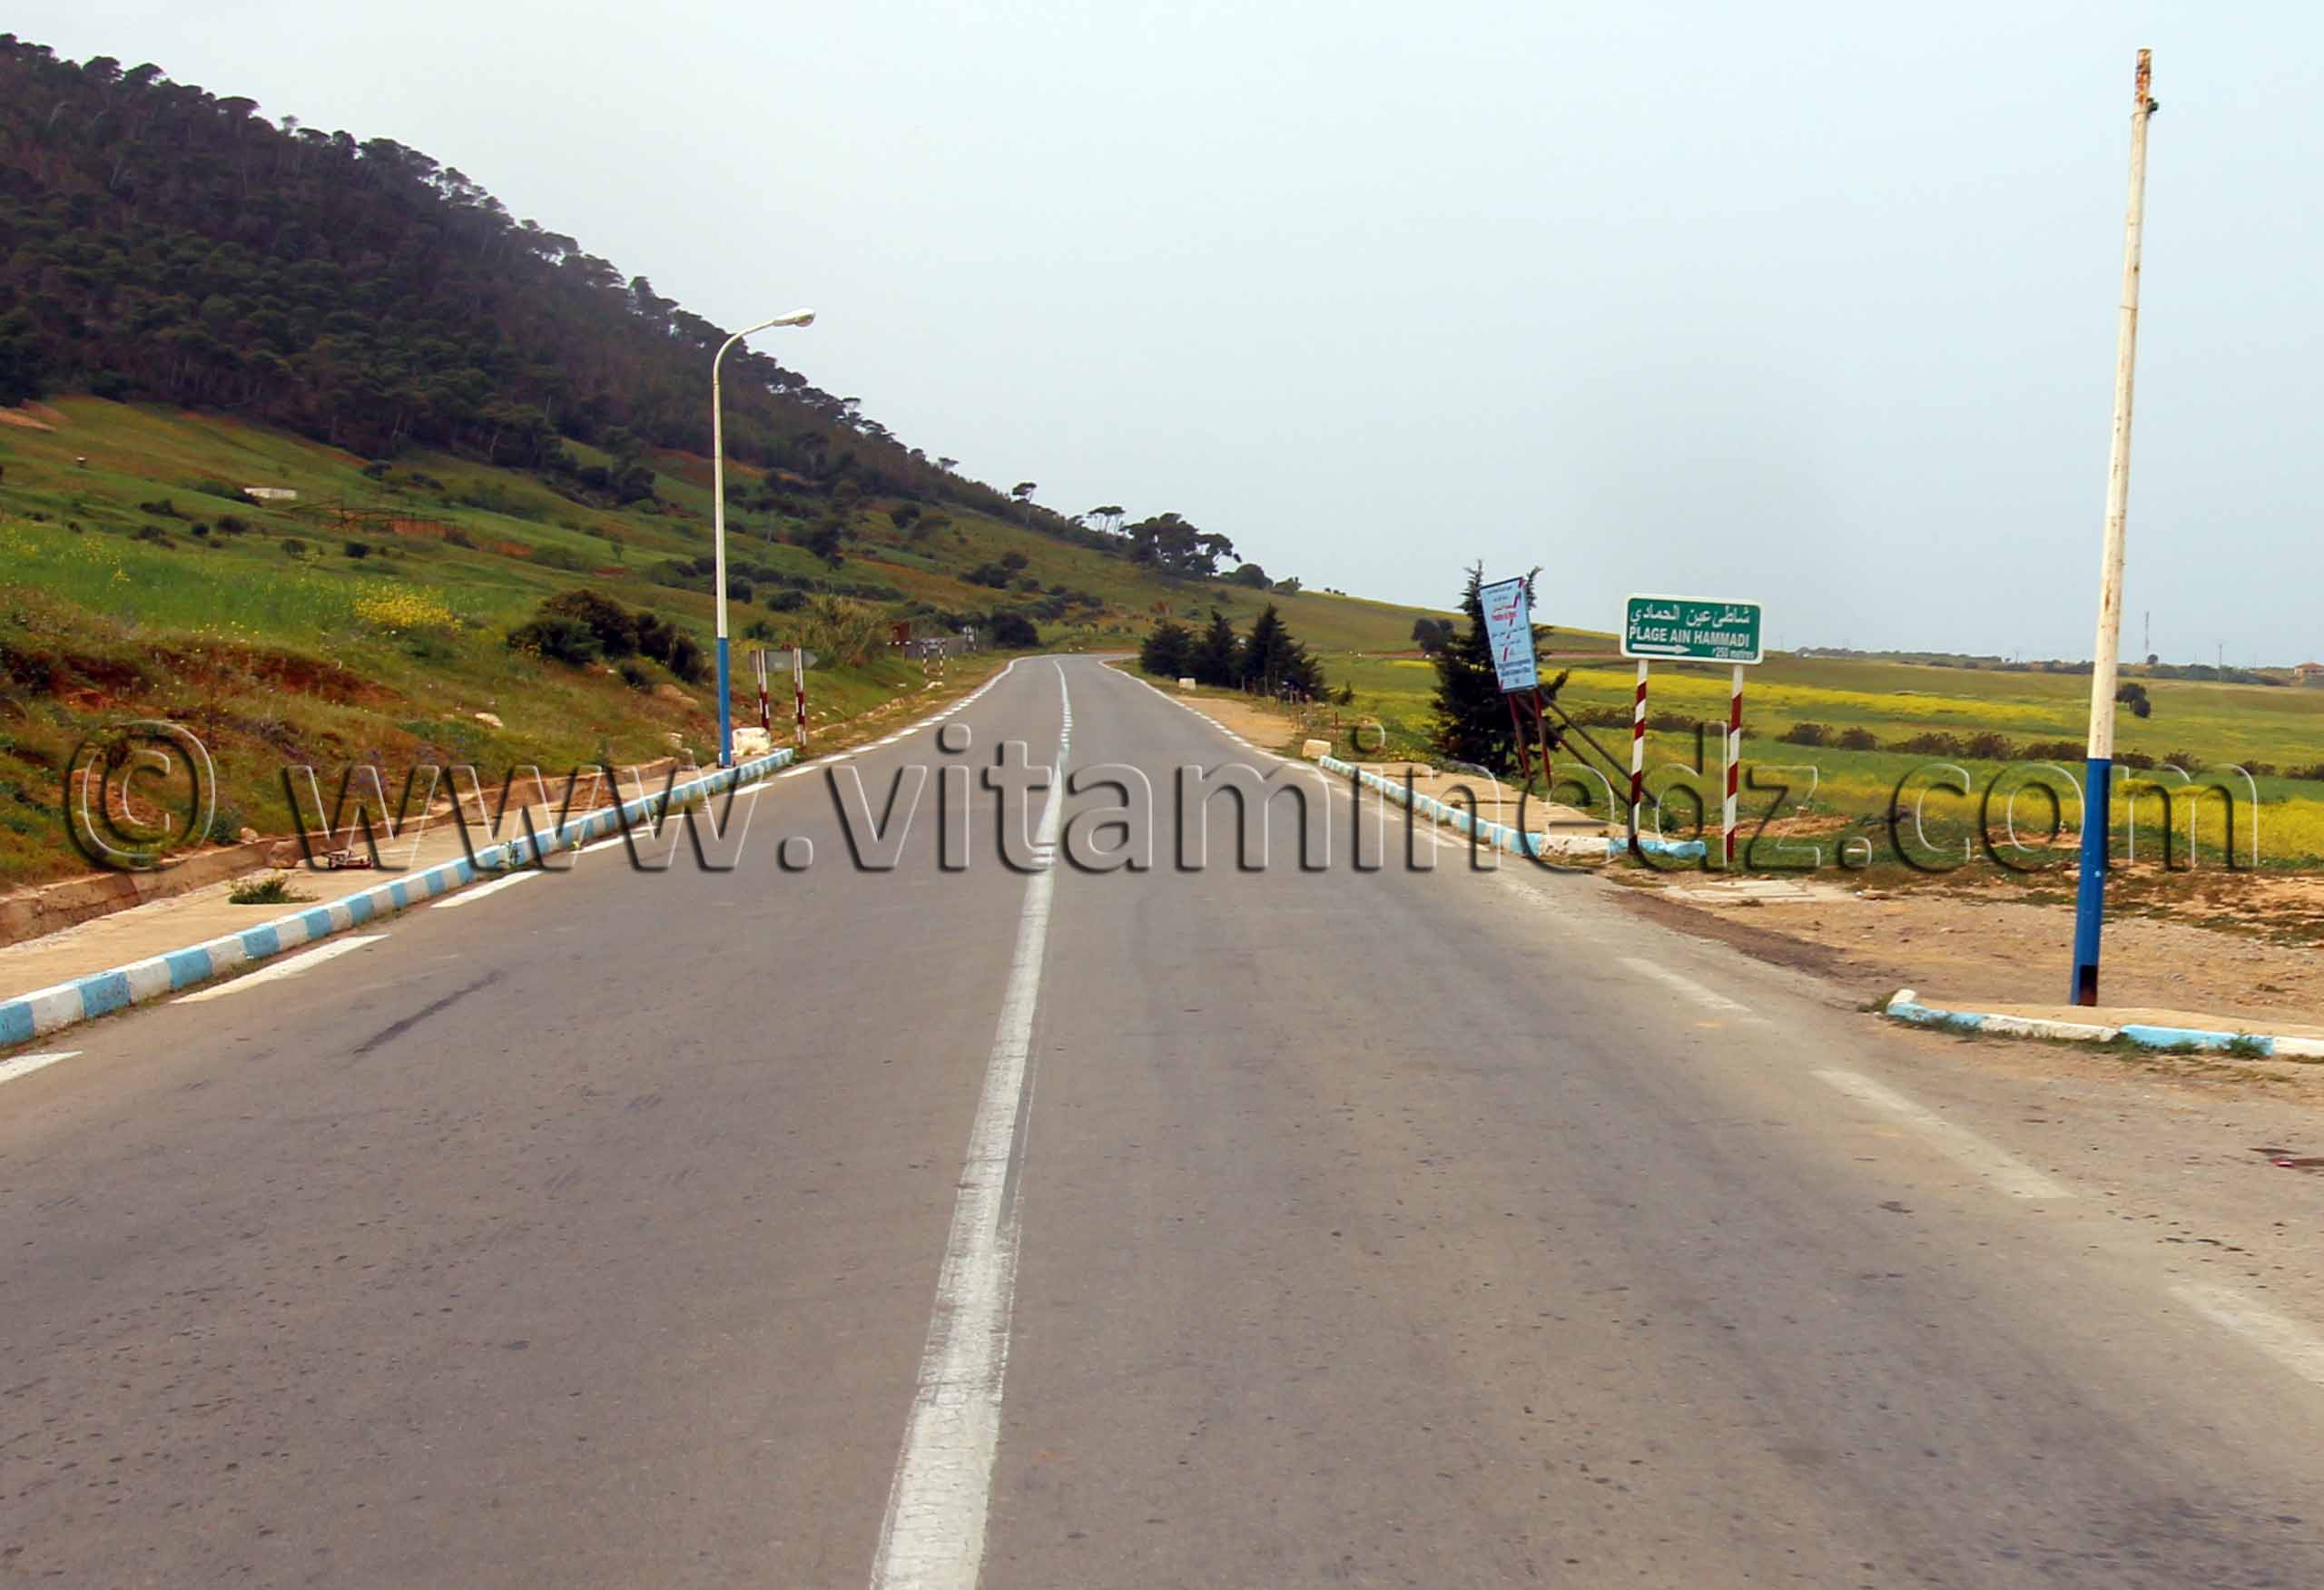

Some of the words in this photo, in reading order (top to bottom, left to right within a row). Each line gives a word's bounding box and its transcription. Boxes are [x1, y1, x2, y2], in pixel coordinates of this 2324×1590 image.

[1630, 603, 1679, 625] الحمادي
[1686, 608, 1711, 627] عين
[1629, 625, 1668, 642] PLAGE
[1670, 628, 1691, 644] AIN
[1694, 630, 1750, 648] HAMMADI
